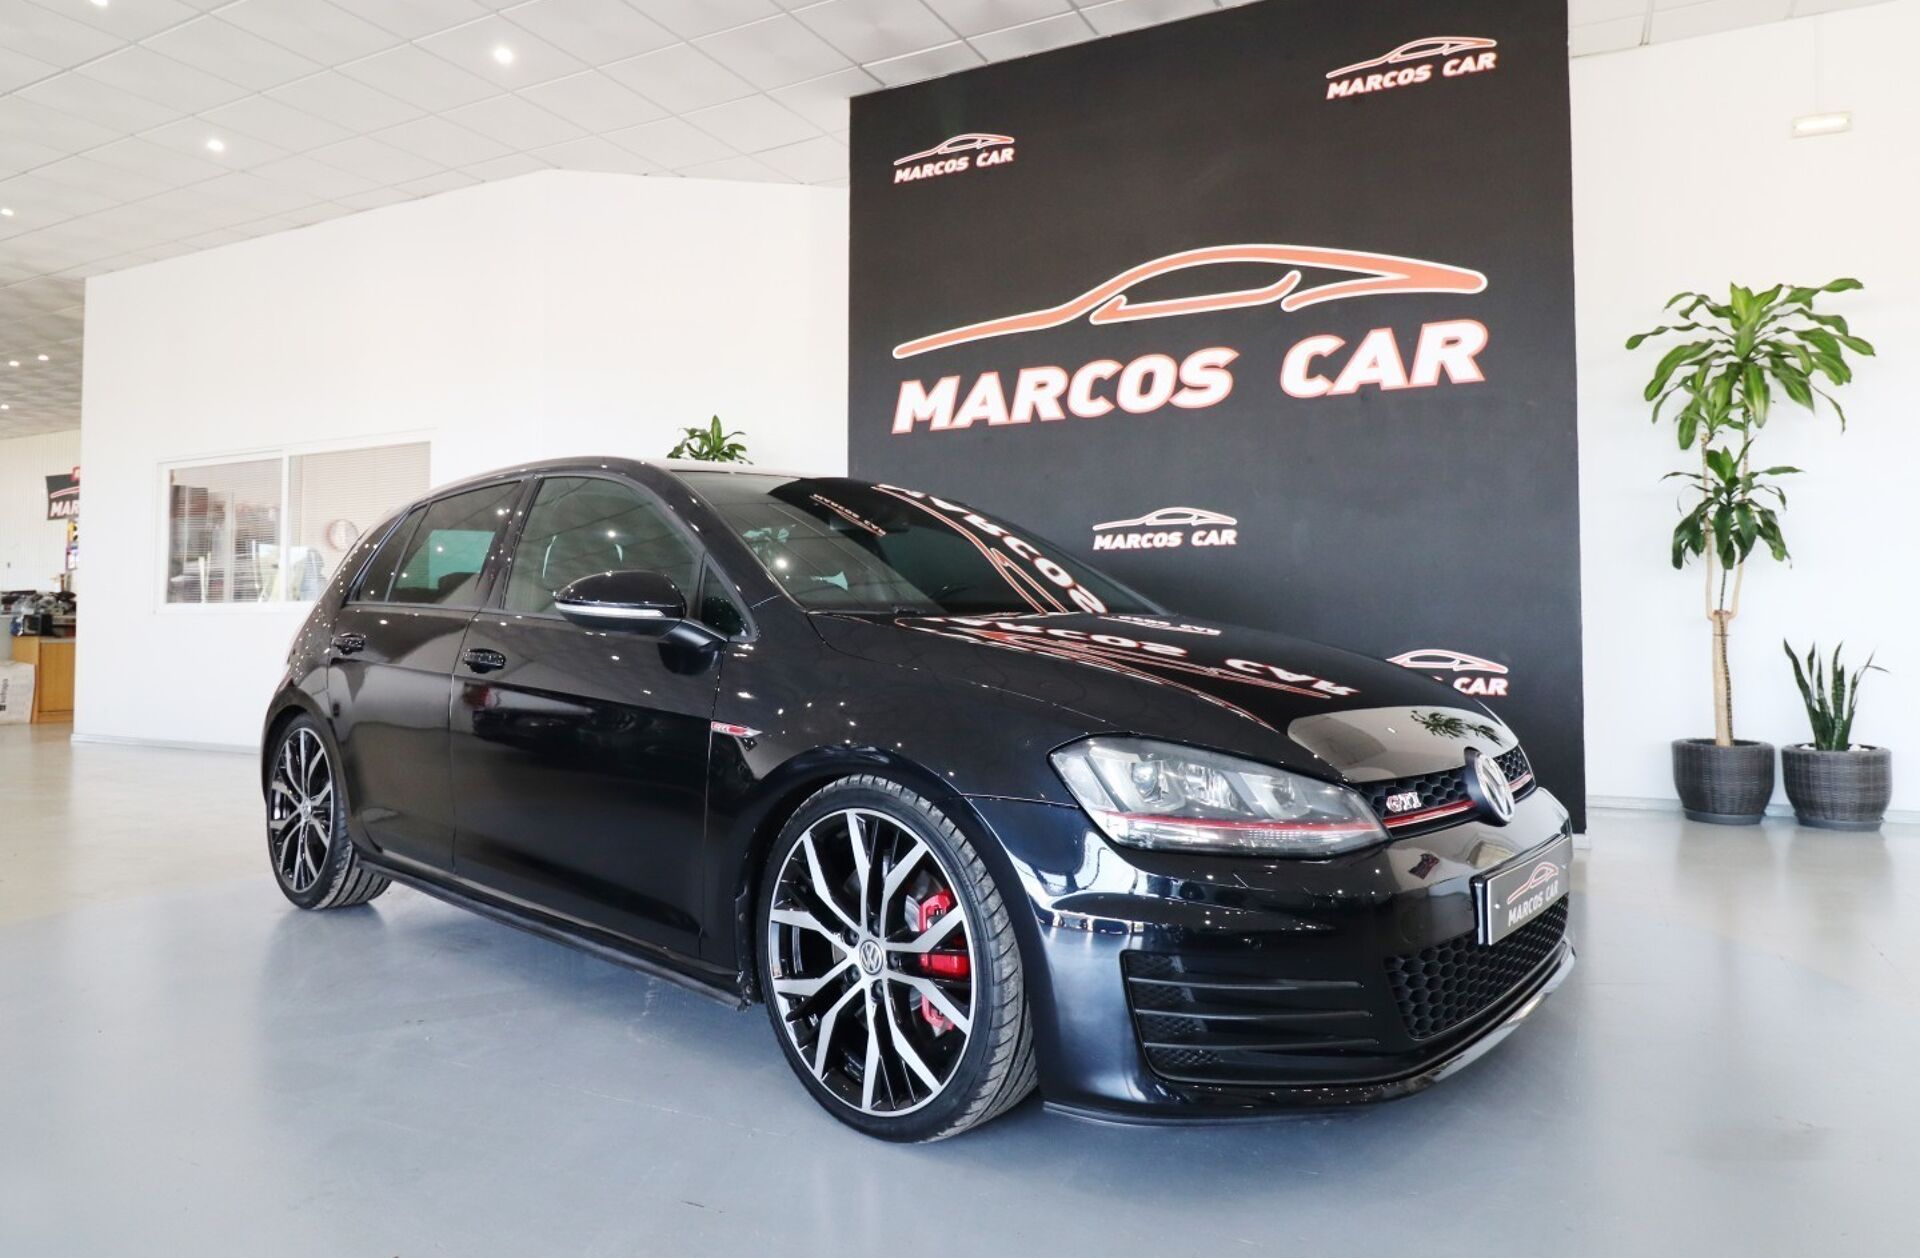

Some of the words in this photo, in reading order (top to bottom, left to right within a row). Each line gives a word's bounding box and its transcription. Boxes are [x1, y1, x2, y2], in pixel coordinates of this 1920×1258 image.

[1326, 63, 1433, 99] MARCOS
[1442, 52, 1497, 77] CAR
[894, 156, 970, 184] MARCOS
[976, 147, 1015, 168] CAR
[892, 346, 1239, 434] MARCOS
[1279, 319, 1489, 398] CAR
[1092, 531, 1184, 550] MARCOS
[1191, 529, 1238, 546] CAR
[1453, 677, 1508, 696] CAR
[1386, 791, 1421, 812] GTI
[1507, 889, 1543, 927] MARCOS
[1545, 879, 1559, 902] CAR
